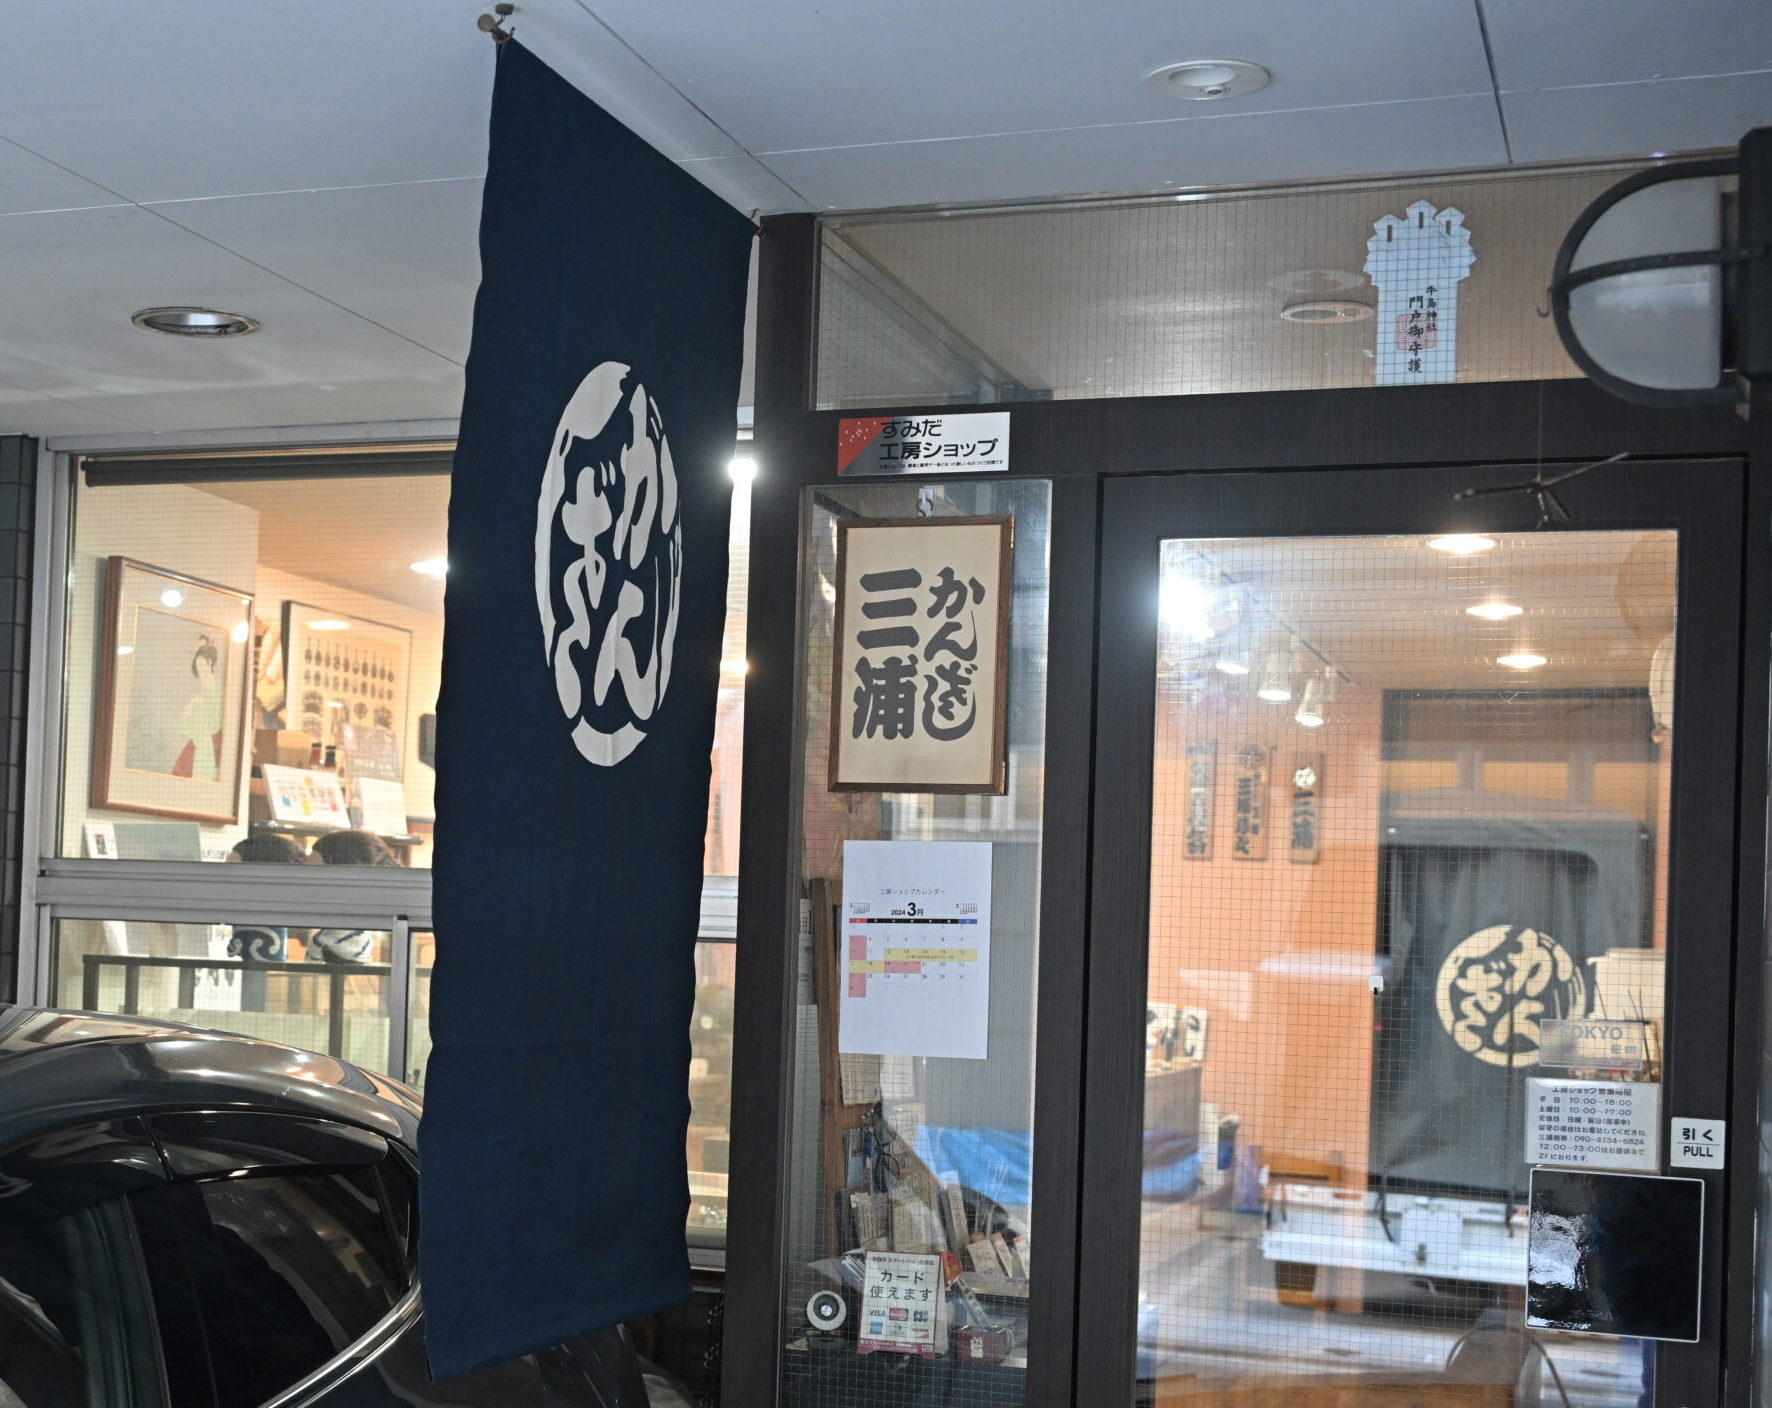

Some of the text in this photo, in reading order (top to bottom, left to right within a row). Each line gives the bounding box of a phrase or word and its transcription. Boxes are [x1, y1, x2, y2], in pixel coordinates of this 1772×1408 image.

[880, 419, 942, 438] すみだ
[879, 438, 999, 460] 工房ショップ
[851, 567, 922, 740] 三浦
[921, 566, 986, 742] かんざし
[891, 909, 906, 917] 2024
[1571, 1025, 1623, 1041] OKYO
[1682, 1128, 1713, 1141] 引く
[1683, 1146, 1713, 1158] PULL
[881, 1270, 924, 1284] カード
[870, 1286, 932, 1301] 使えます
[869, 1309, 886, 1317] VISA
